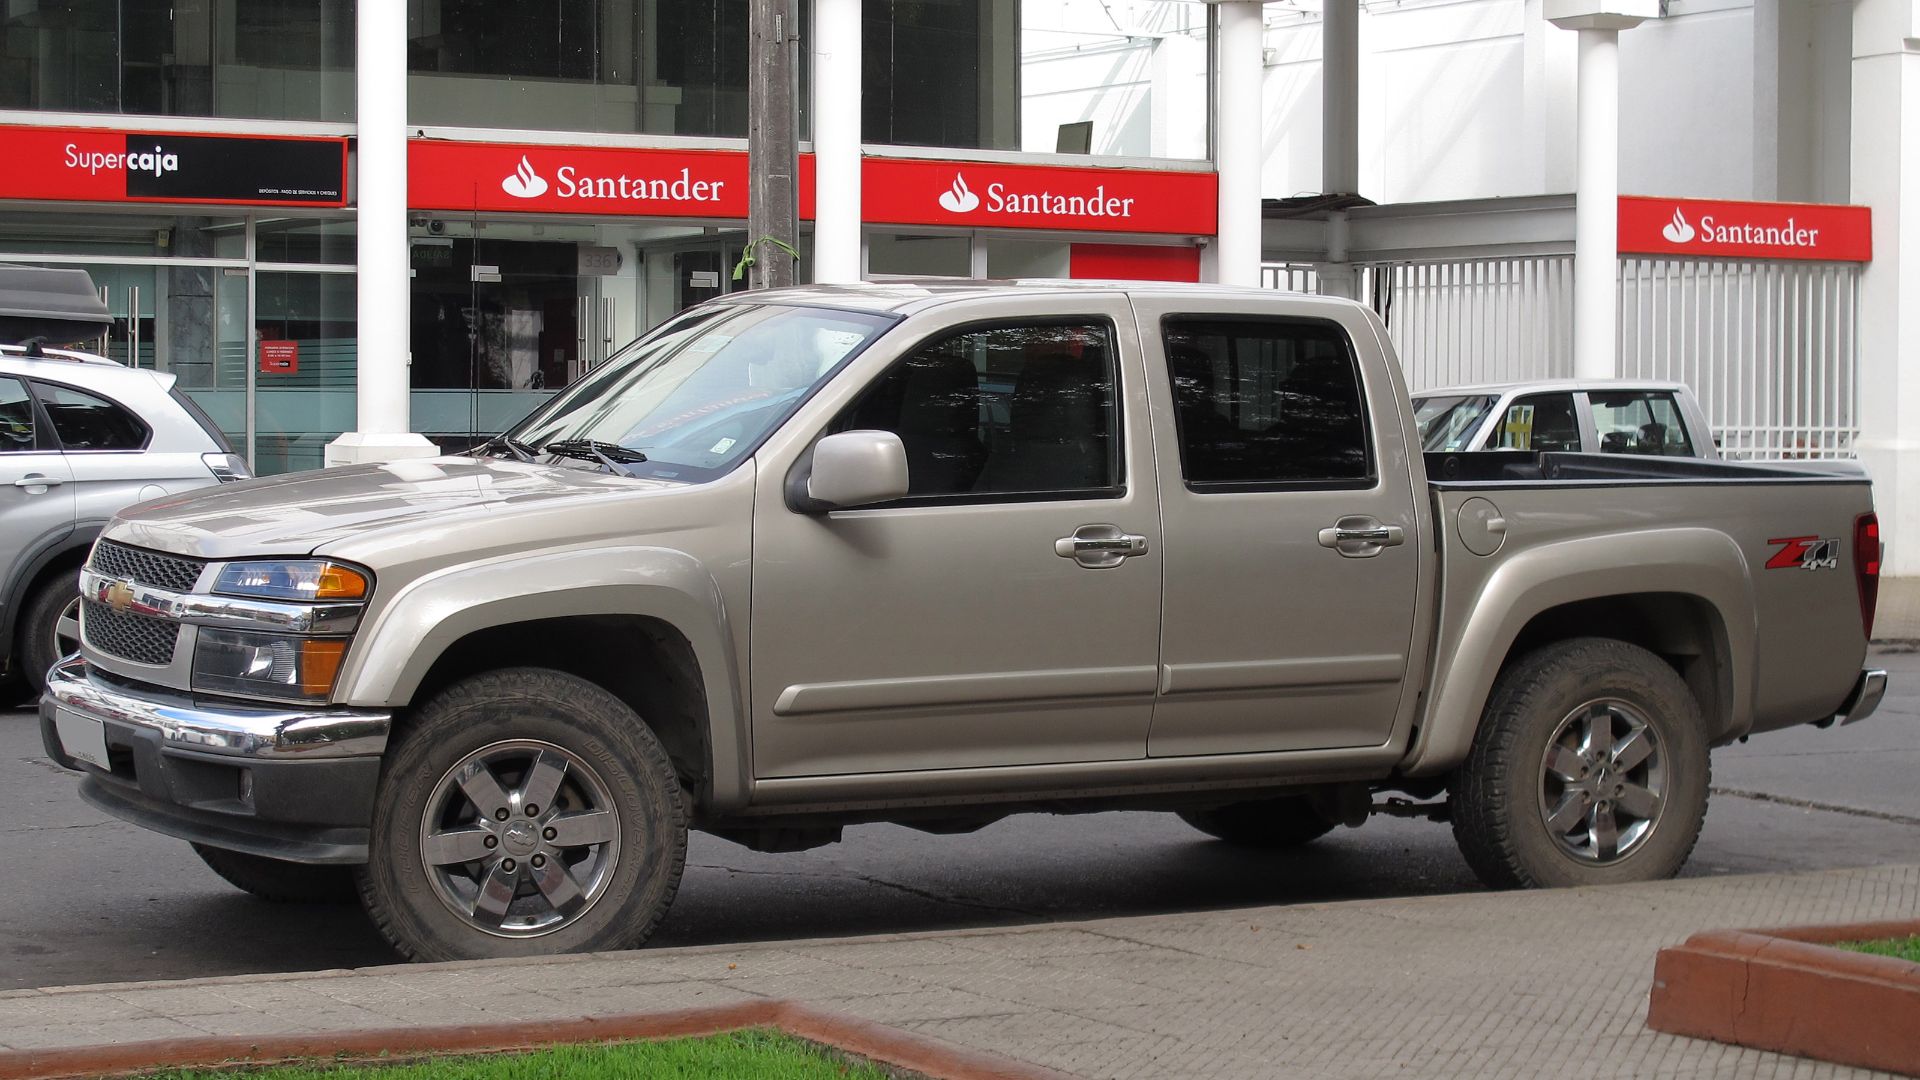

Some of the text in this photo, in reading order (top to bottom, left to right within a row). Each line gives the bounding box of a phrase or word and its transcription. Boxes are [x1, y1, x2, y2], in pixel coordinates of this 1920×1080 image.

[65, 143, 179, 178] Supercaja
[556, 166, 724, 201] Santander
[987, 183, 1134, 217] Santander
[1701, 216, 1818, 247] Santander
[585, 254, 612, 268] 336
[1764, 534, 1840, 569] Z71
